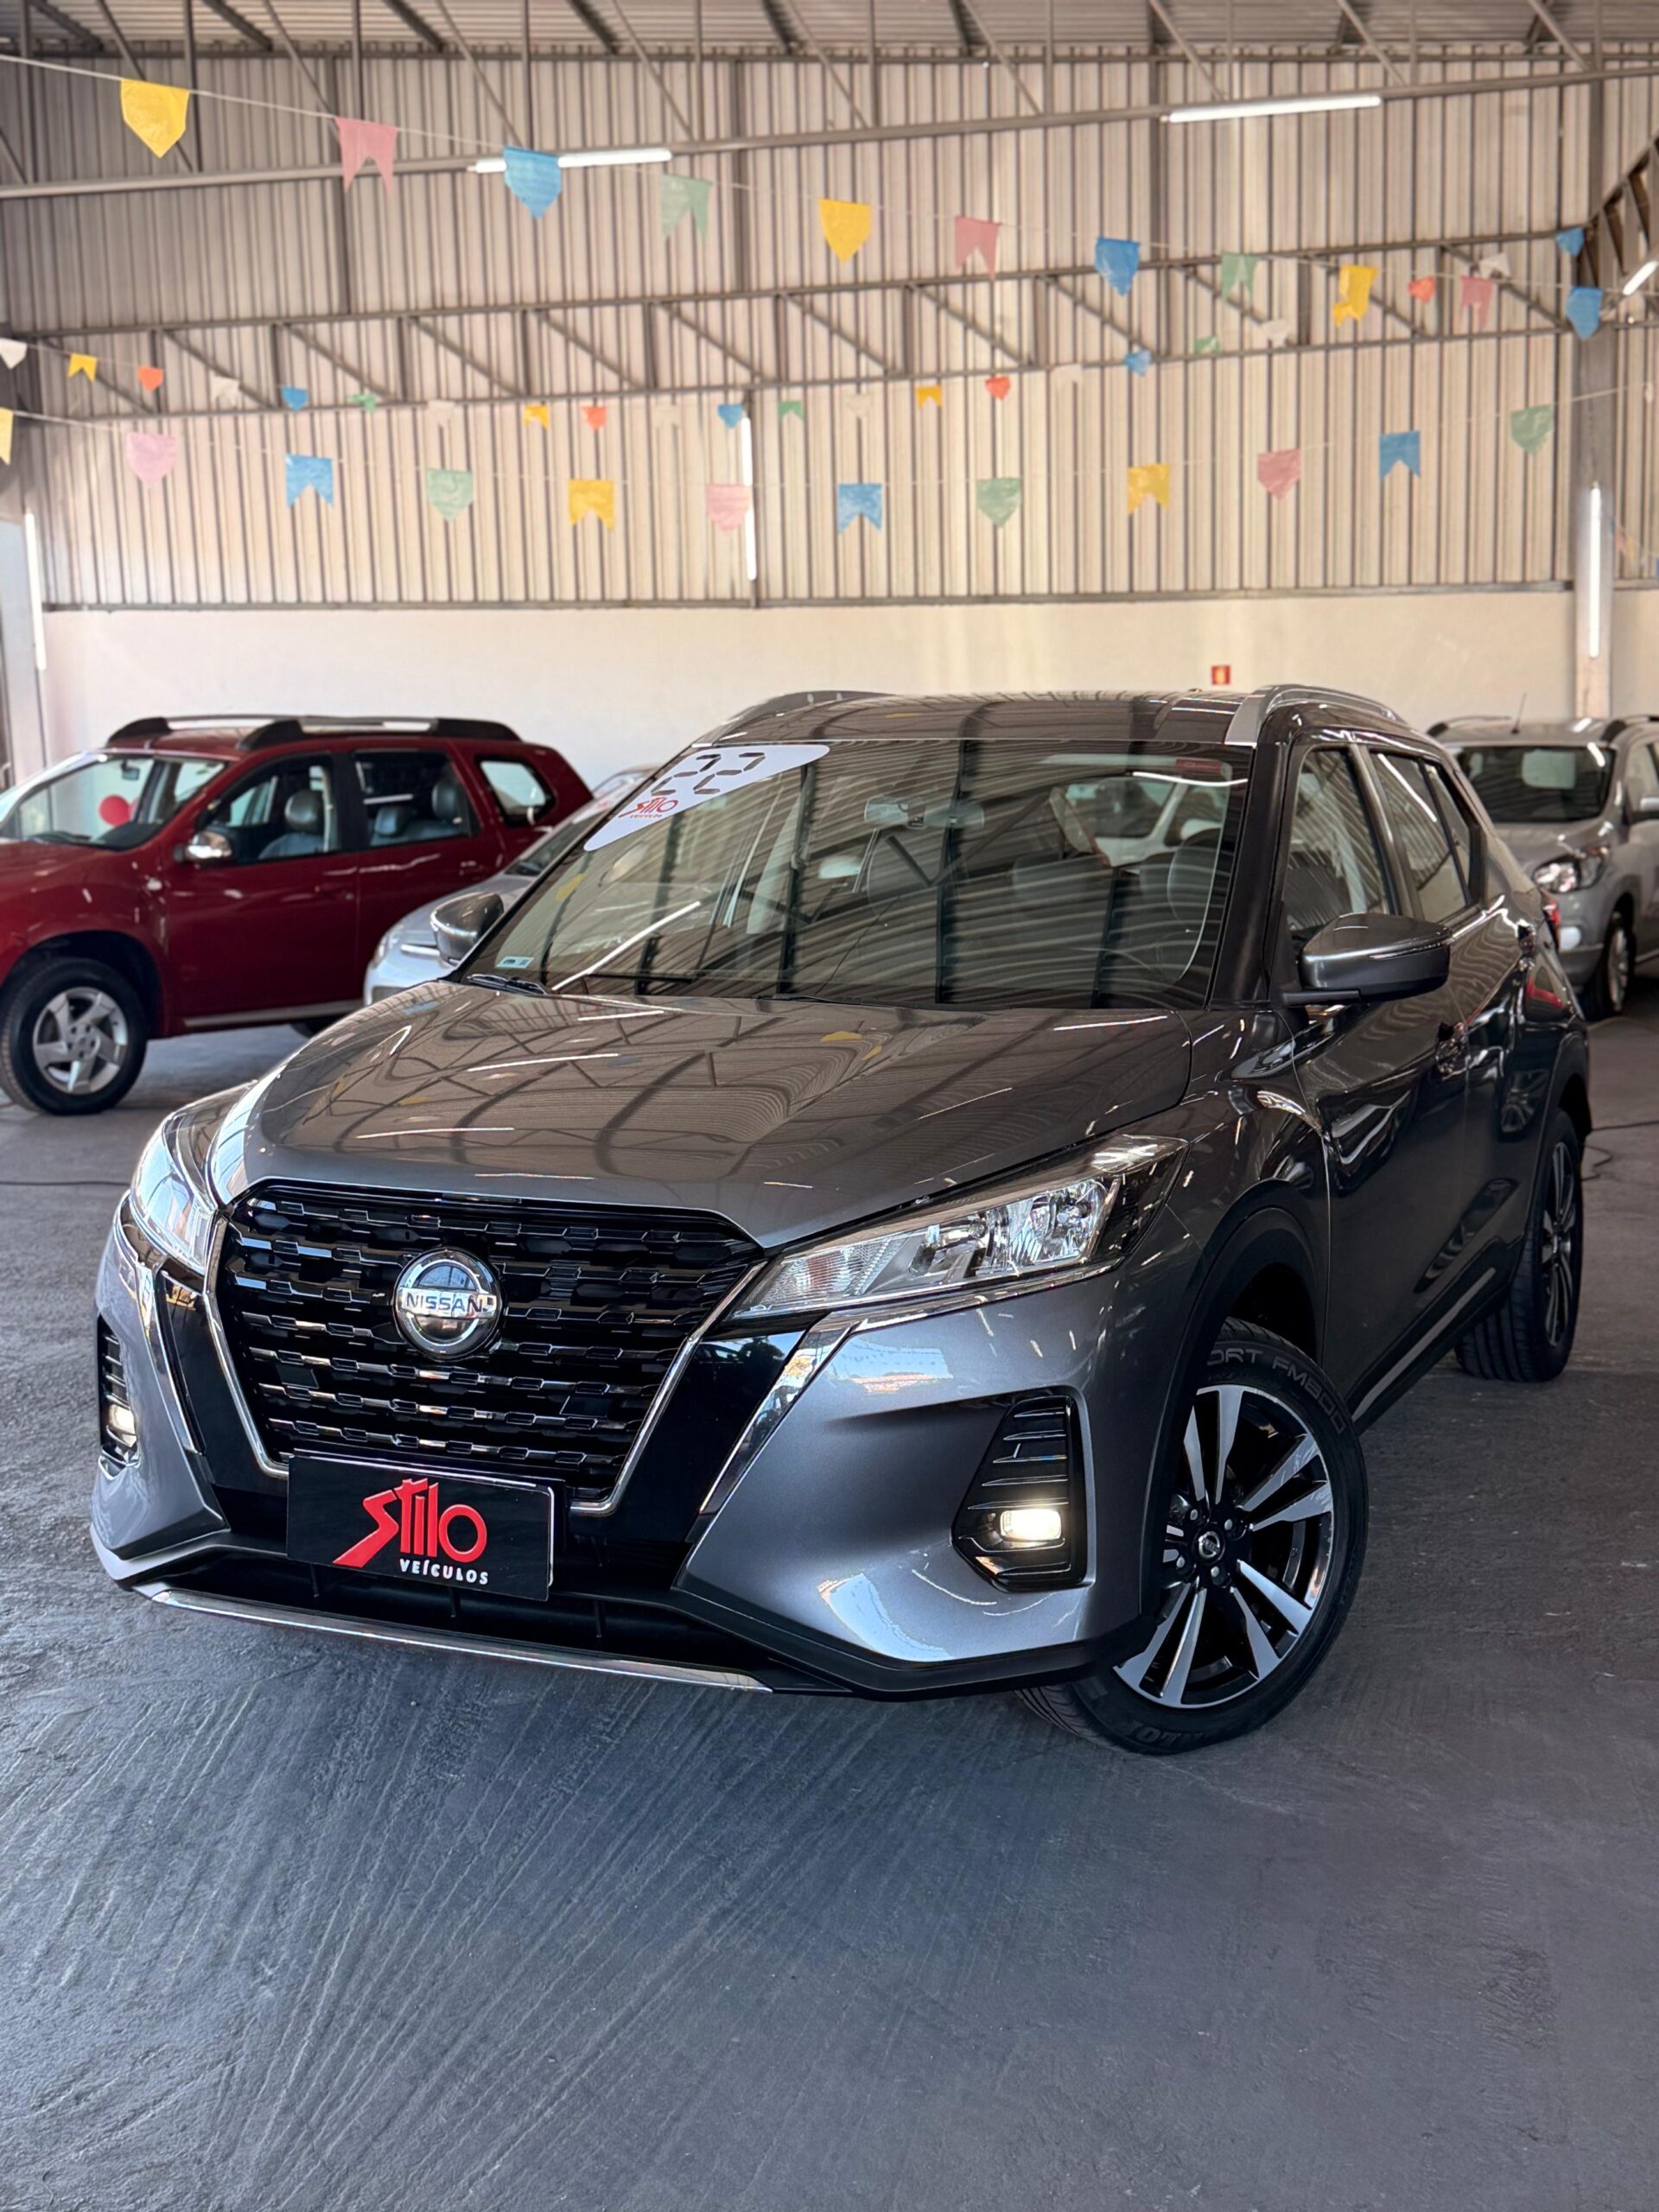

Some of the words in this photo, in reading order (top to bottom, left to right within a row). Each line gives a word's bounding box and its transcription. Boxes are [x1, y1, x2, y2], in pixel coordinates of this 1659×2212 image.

[651, 752, 766, 797] 22
[406, 1293, 483, 1313] NISSAN
[1206, 1347, 1264, 1367] ORT
[1272, 1355, 1348, 1435] FM800
